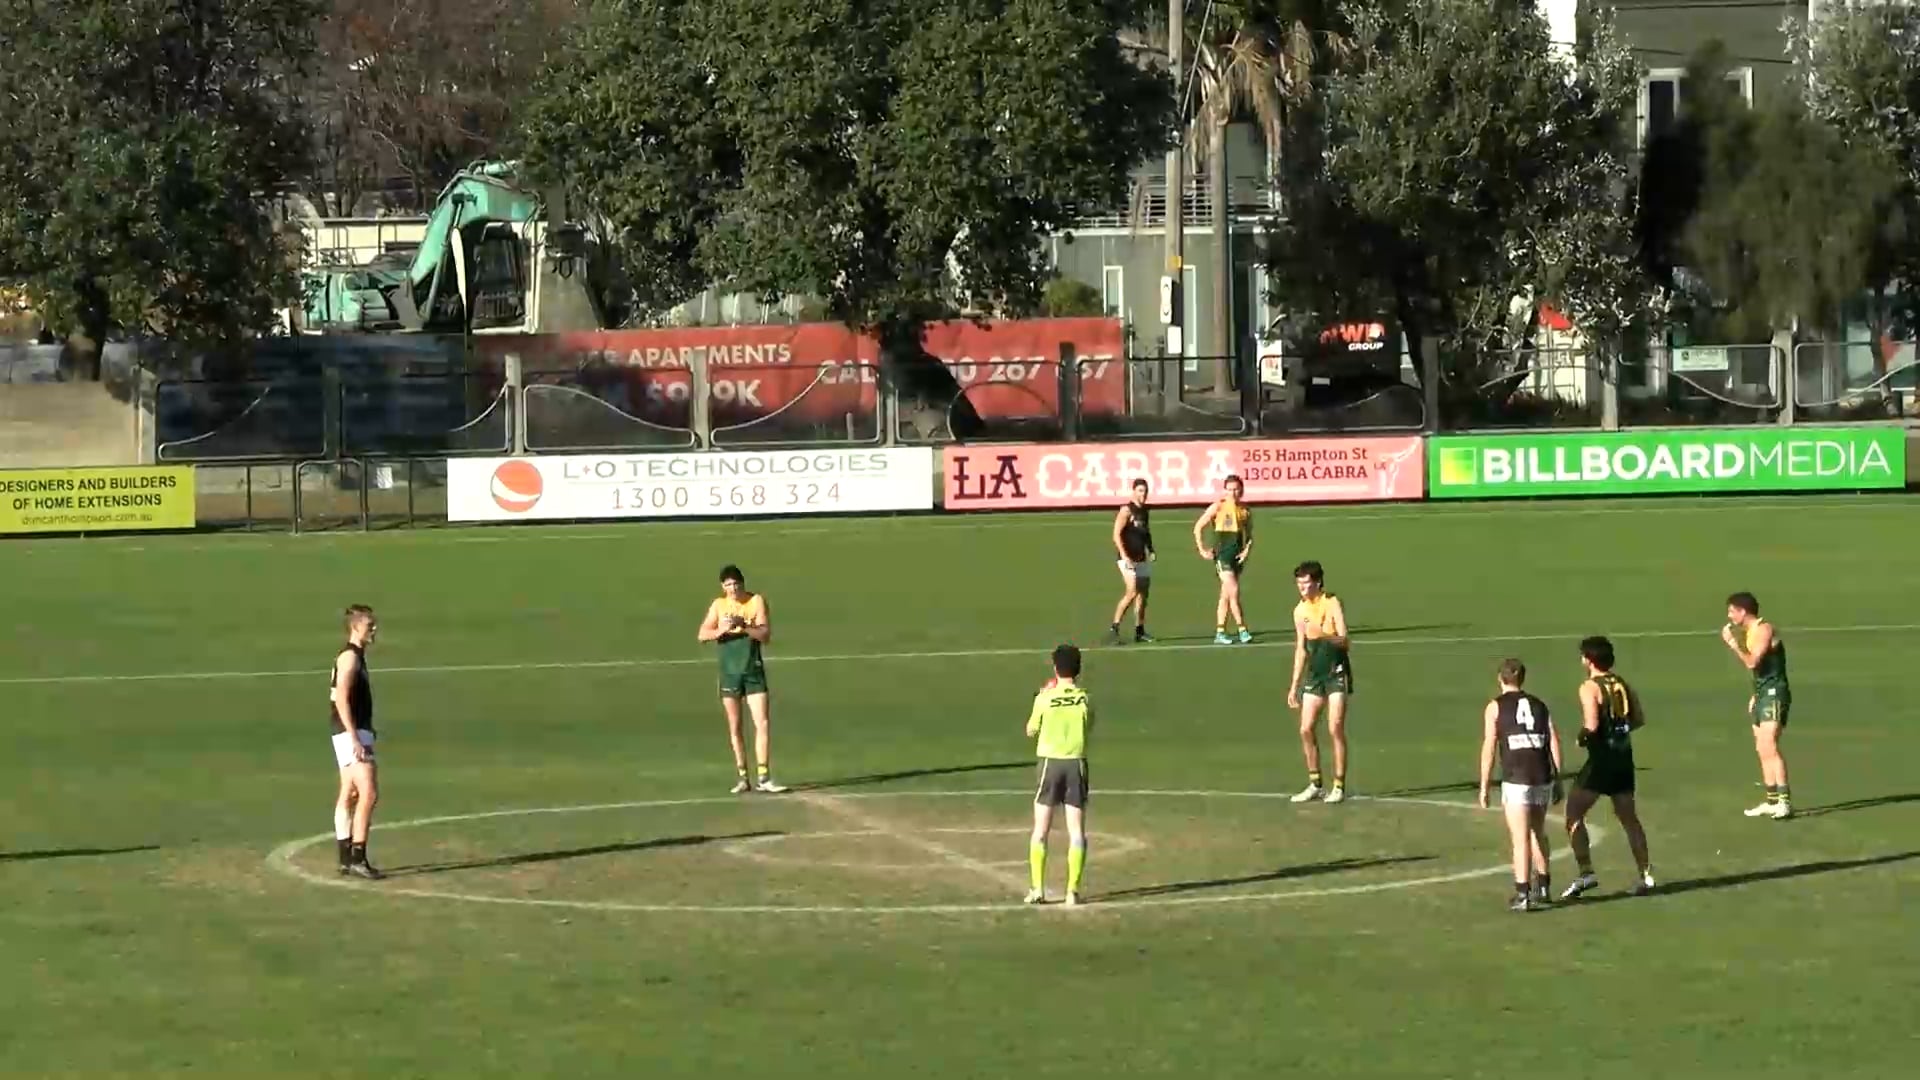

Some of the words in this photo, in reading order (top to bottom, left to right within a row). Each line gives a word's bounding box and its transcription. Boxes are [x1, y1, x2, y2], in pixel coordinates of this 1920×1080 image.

[1348, 342, 1384, 351] GROUP
[817, 358, 876, 384] CAL
[987, 355, 1045, 382] 267
[626, 453, 888, 478] TECHNOLOGIES
[1243, 449, 1271, 462] 265
[1276, 448, 1348, 464] Hampton
[1352, 447, 1368, 460] St
[953, 455, 1027, 500] LA
[1035, 450, 1237, 499] CABRA
[1287, 467, 1307, 480] LA
[1312, 465, 1368, 479] CABRA
[0, 480, 74, 493] DESIGNERS
[78, 478, 106, 491] AND
[110, 476, 177, 489] BUILDERS
[13, 498, 31, 511] OF
[35, 497, 74, 510] HOME
[78, 494, 162, 509] EXTENSIONS
[612, 486, 689, 509] 1300
[709, 484, 766, 507] 568
[786, 482, 841, 505] 324
[1516, 698, 1534, 730] 4
